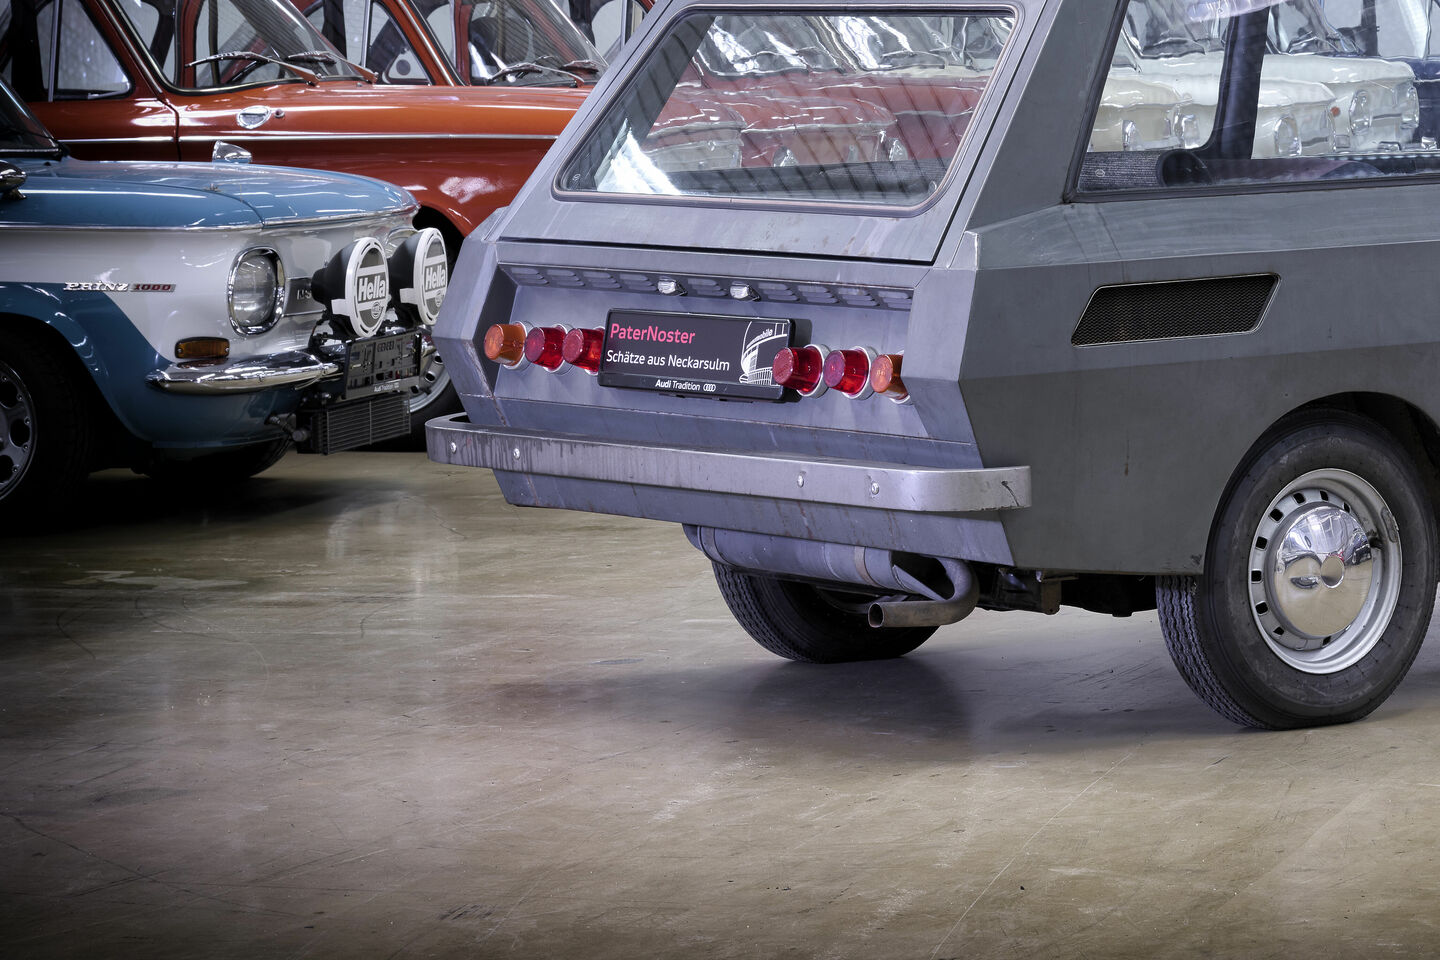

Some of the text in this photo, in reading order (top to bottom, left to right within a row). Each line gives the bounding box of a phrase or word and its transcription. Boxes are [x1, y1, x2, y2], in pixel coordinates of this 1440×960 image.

[133, 283, 172, 291] 1000
[426, 264, 446, 290] Hella
[358, 276, 386, 302] Hella
[610, 323, 696, 344] PaterNoster
[606, 350, 730, 371] Schätze aus Neckarsulm
[655, 380, 701, 391] Audi Tradition
